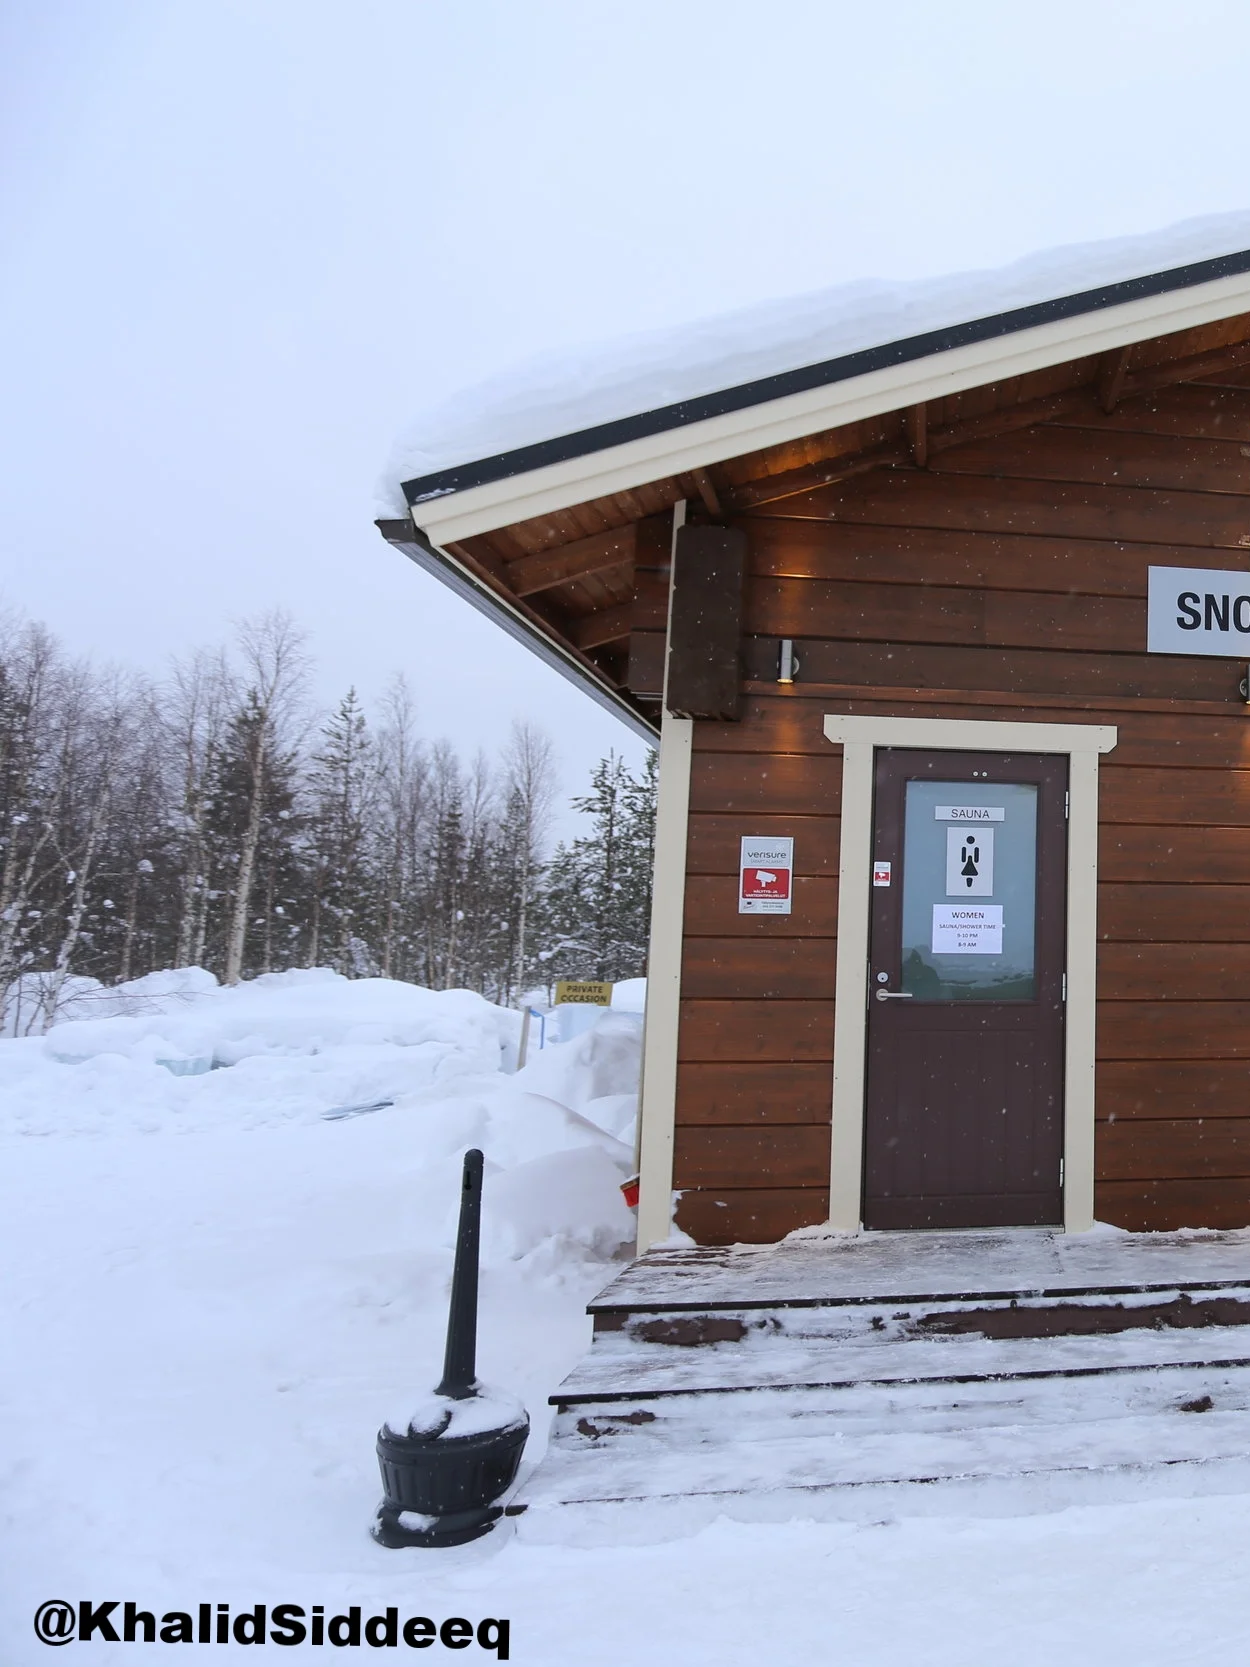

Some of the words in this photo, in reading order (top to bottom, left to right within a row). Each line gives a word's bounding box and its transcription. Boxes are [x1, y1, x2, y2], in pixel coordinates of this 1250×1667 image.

[951, 809, 990, 819] SAUNA
[747, 851, 787, 859] verisure
[951, 911, 985, 919] WOMEN
[566, 985, 604, 993] PRIVATE
[561, 994, 607, 1003] OCCASION
